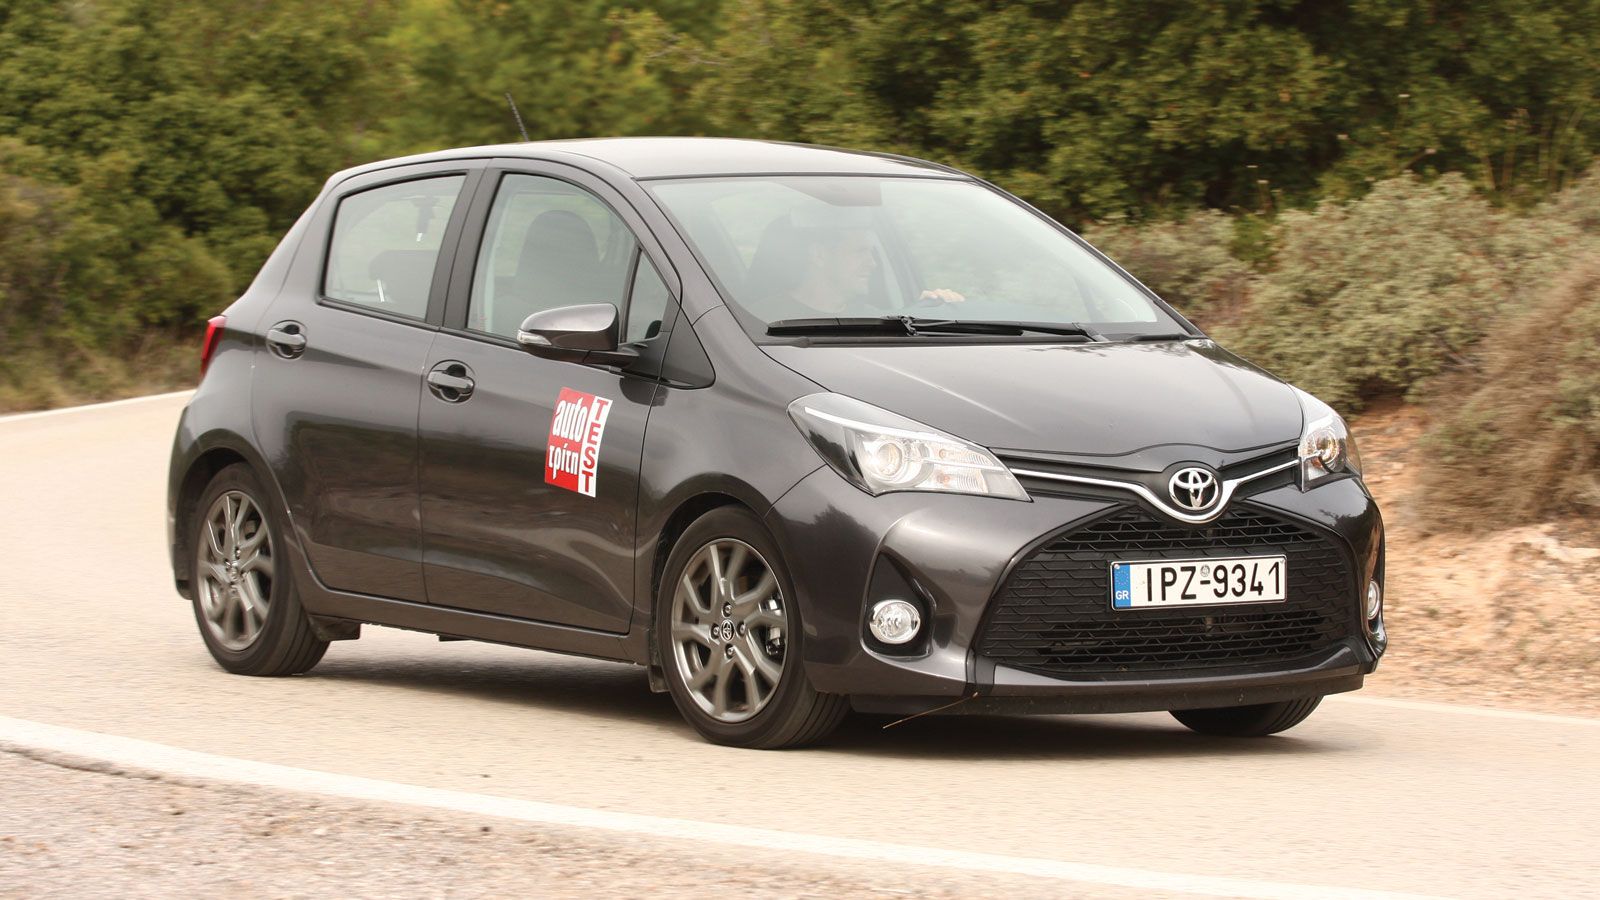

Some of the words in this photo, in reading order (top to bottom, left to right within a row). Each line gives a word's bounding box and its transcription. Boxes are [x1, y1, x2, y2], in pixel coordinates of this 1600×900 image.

[552, 397, 588, 443] auto
[582, 399, 609, 493] TEST
[1115, 590, 1130, 601] GR
[1146, 561, 1280, 602] IPZ-9341
